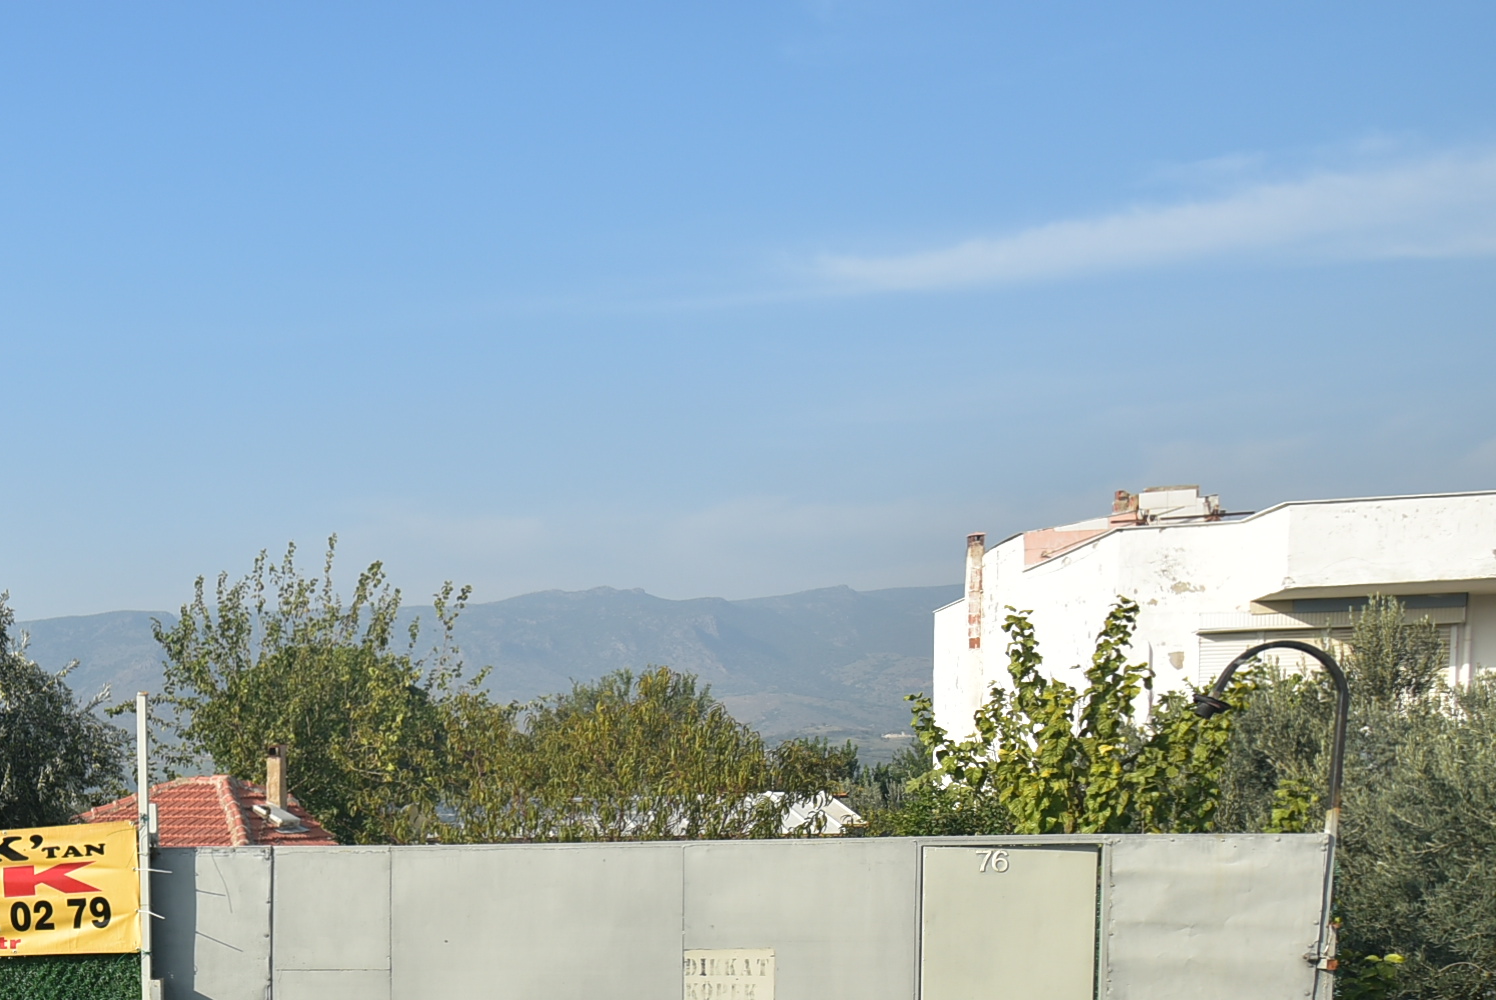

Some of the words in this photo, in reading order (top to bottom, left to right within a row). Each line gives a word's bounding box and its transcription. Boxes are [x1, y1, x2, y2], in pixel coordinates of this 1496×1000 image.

[975, 850, 1009, 873] 76
[10, 900, 55, 932] 02
[67, 897, 111, 929] 79
